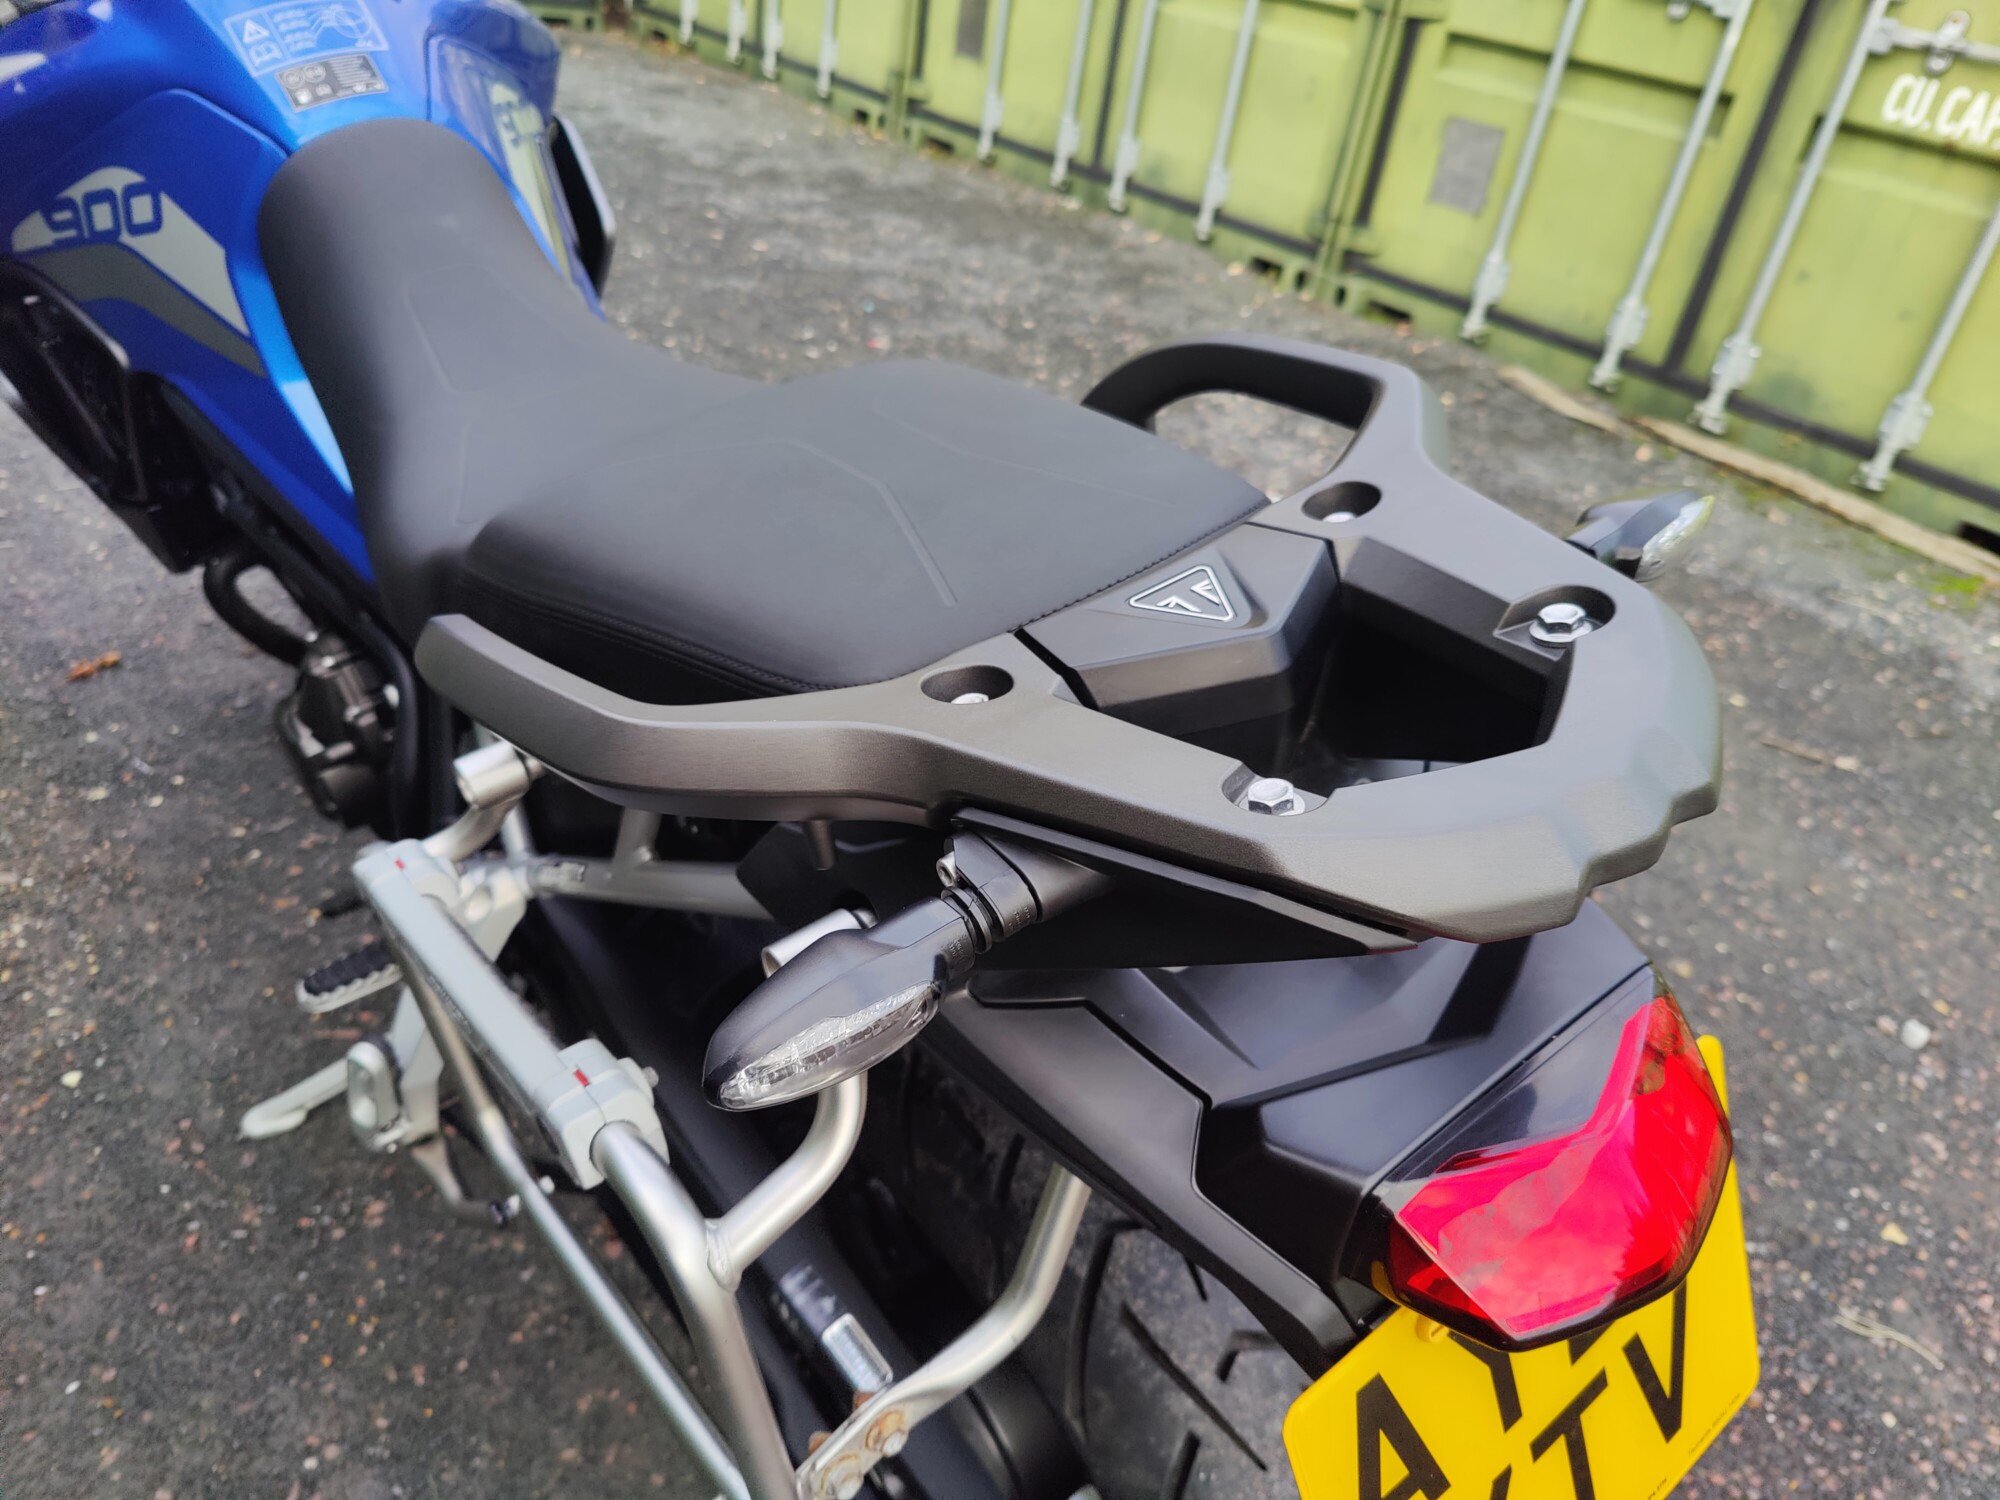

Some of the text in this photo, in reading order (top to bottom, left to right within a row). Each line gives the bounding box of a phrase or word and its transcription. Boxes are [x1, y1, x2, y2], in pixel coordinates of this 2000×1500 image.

[43, 182, 162, 245] 900
[1356, 1320, 1617, 1500] AY
[1490, 1282, 1687, 1500] TV
